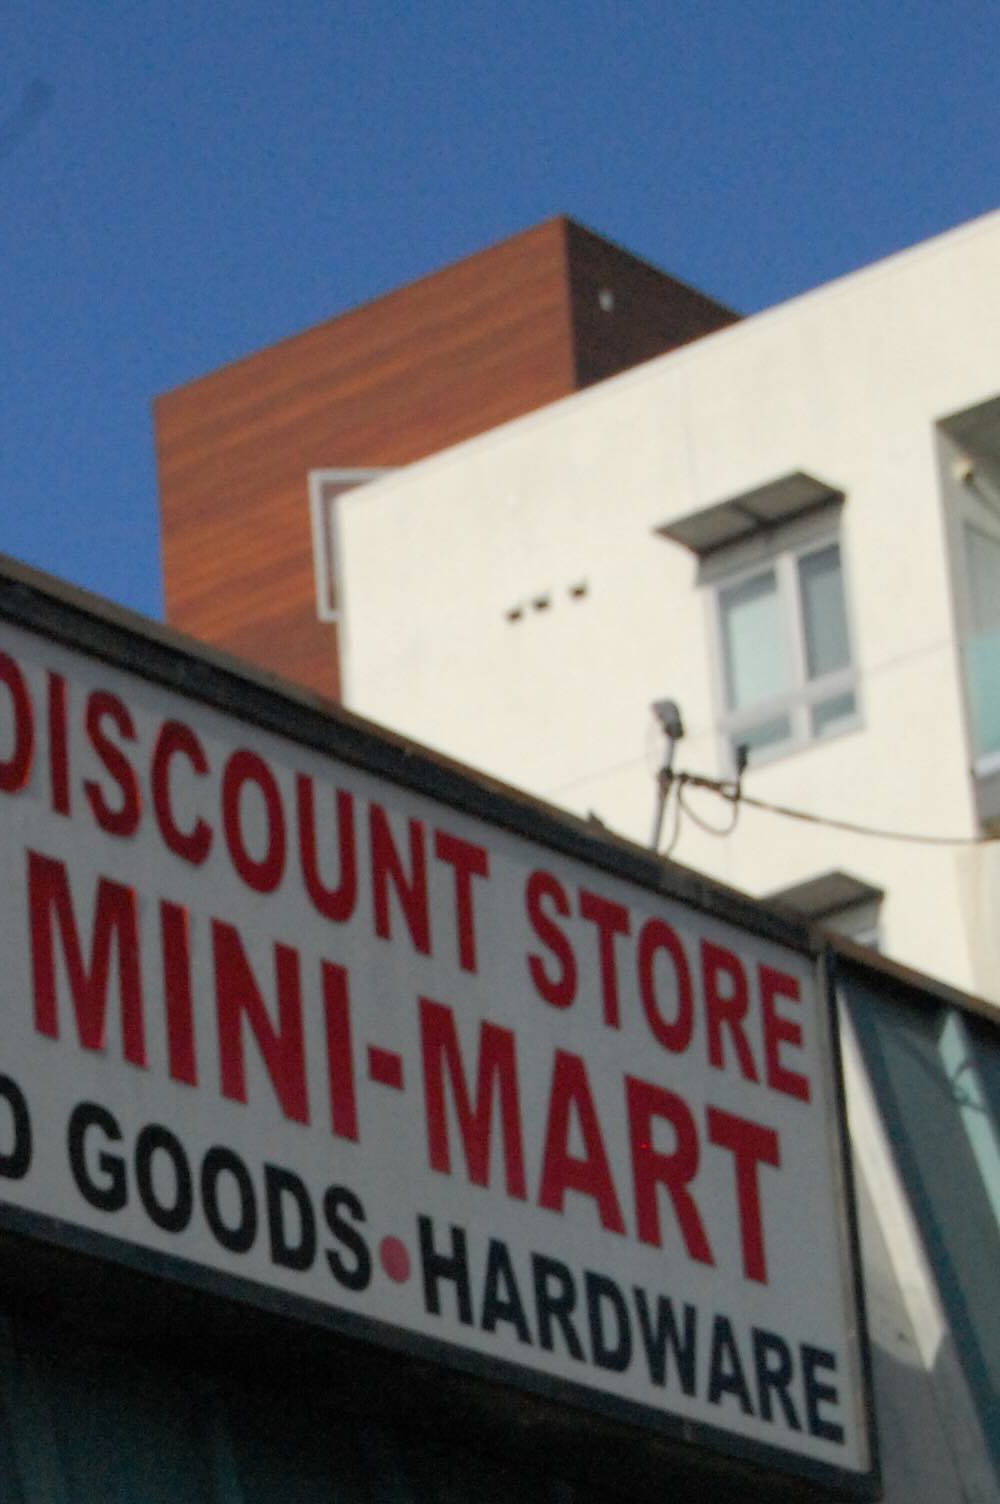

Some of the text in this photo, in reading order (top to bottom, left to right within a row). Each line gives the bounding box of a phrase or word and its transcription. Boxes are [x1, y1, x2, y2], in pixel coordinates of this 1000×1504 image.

[26, 848, 782, 1286] MINI-MART
[523, 868, 811, 1104] STORE
[417, 1213, 846, 1446] HARDWARE
